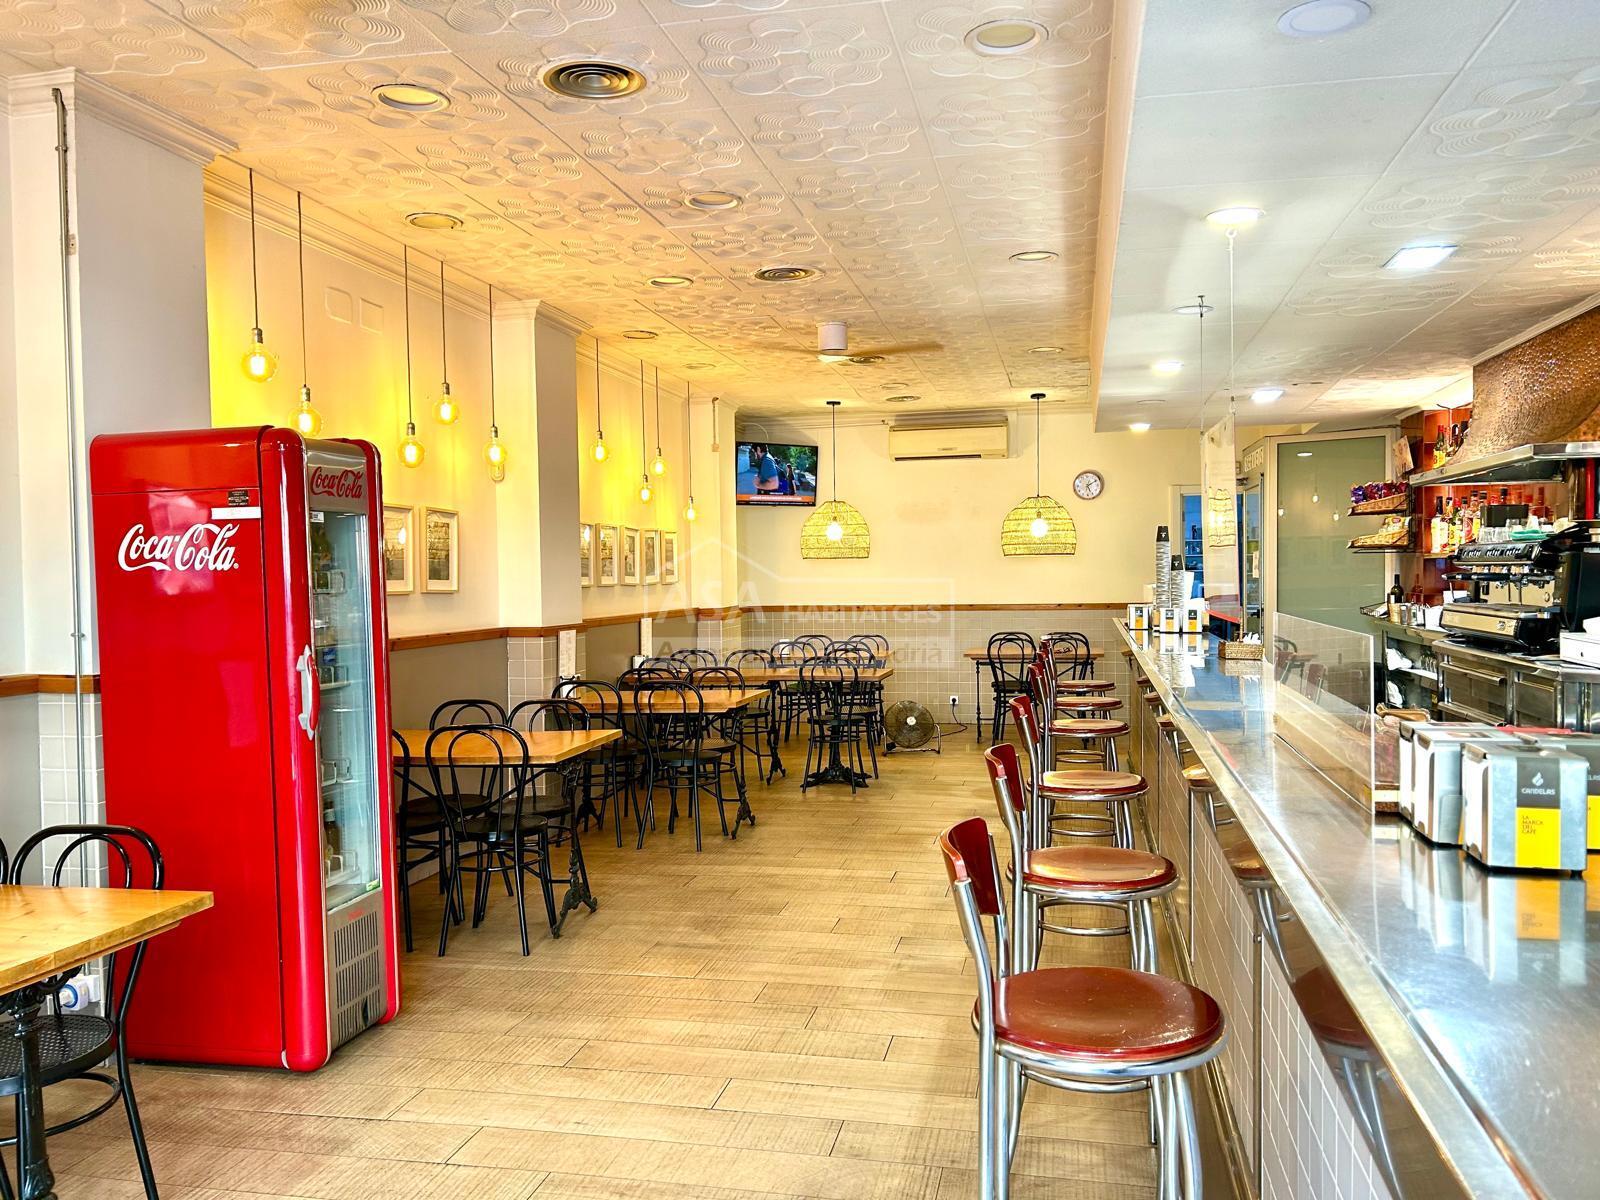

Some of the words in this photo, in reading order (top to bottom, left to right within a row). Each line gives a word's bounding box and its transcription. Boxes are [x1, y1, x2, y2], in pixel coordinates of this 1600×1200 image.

[310, 466, 363, 499] Coca-Cola
[118, 523, 240, 572] Coca-Cola
[1521, 787, 1556, 795] CANDELAS
